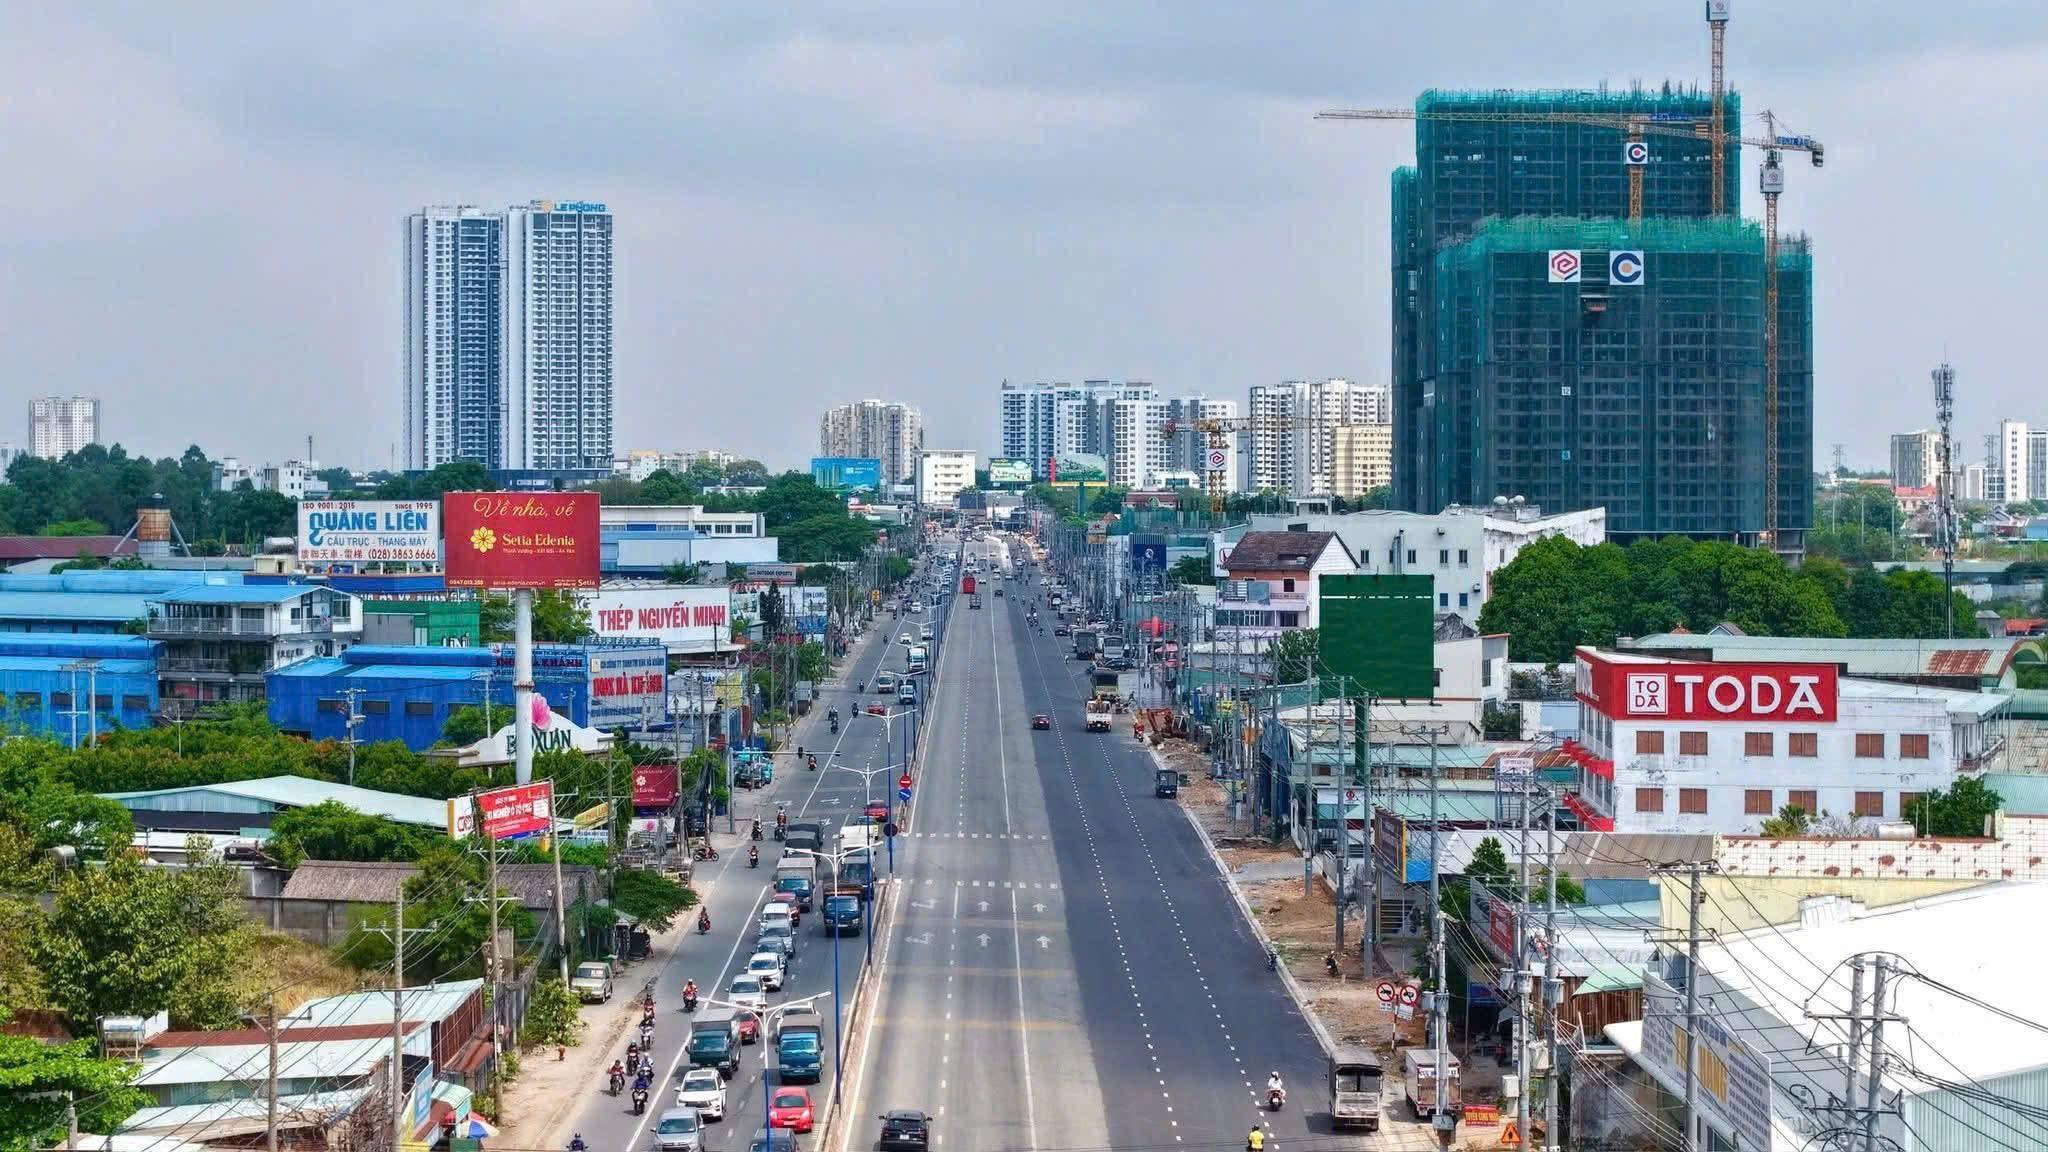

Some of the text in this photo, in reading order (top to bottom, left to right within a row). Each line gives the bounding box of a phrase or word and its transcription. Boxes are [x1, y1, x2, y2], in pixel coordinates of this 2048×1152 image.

[474, 498, 511, 517] Về
[555, 500, 576, 517] về
[309, 507, 428, 546] QUẢNG LIÊN
[378, 537, 406, 546] THANG
[409, 535, 428, 546] MÁY
[502, 532, 575, 546] Setia Edenia
[368, 549, 436, 560] (028) 3863 6666
[598, 601, 726, 631] THÉP NGUYỄN MINH
[592, 677, 615, 697] INOX
[1635, 680, 1660, 695] TO
[1674, 674, 1824, 714] TODA
[1635, 694, 1660, 708] DA
